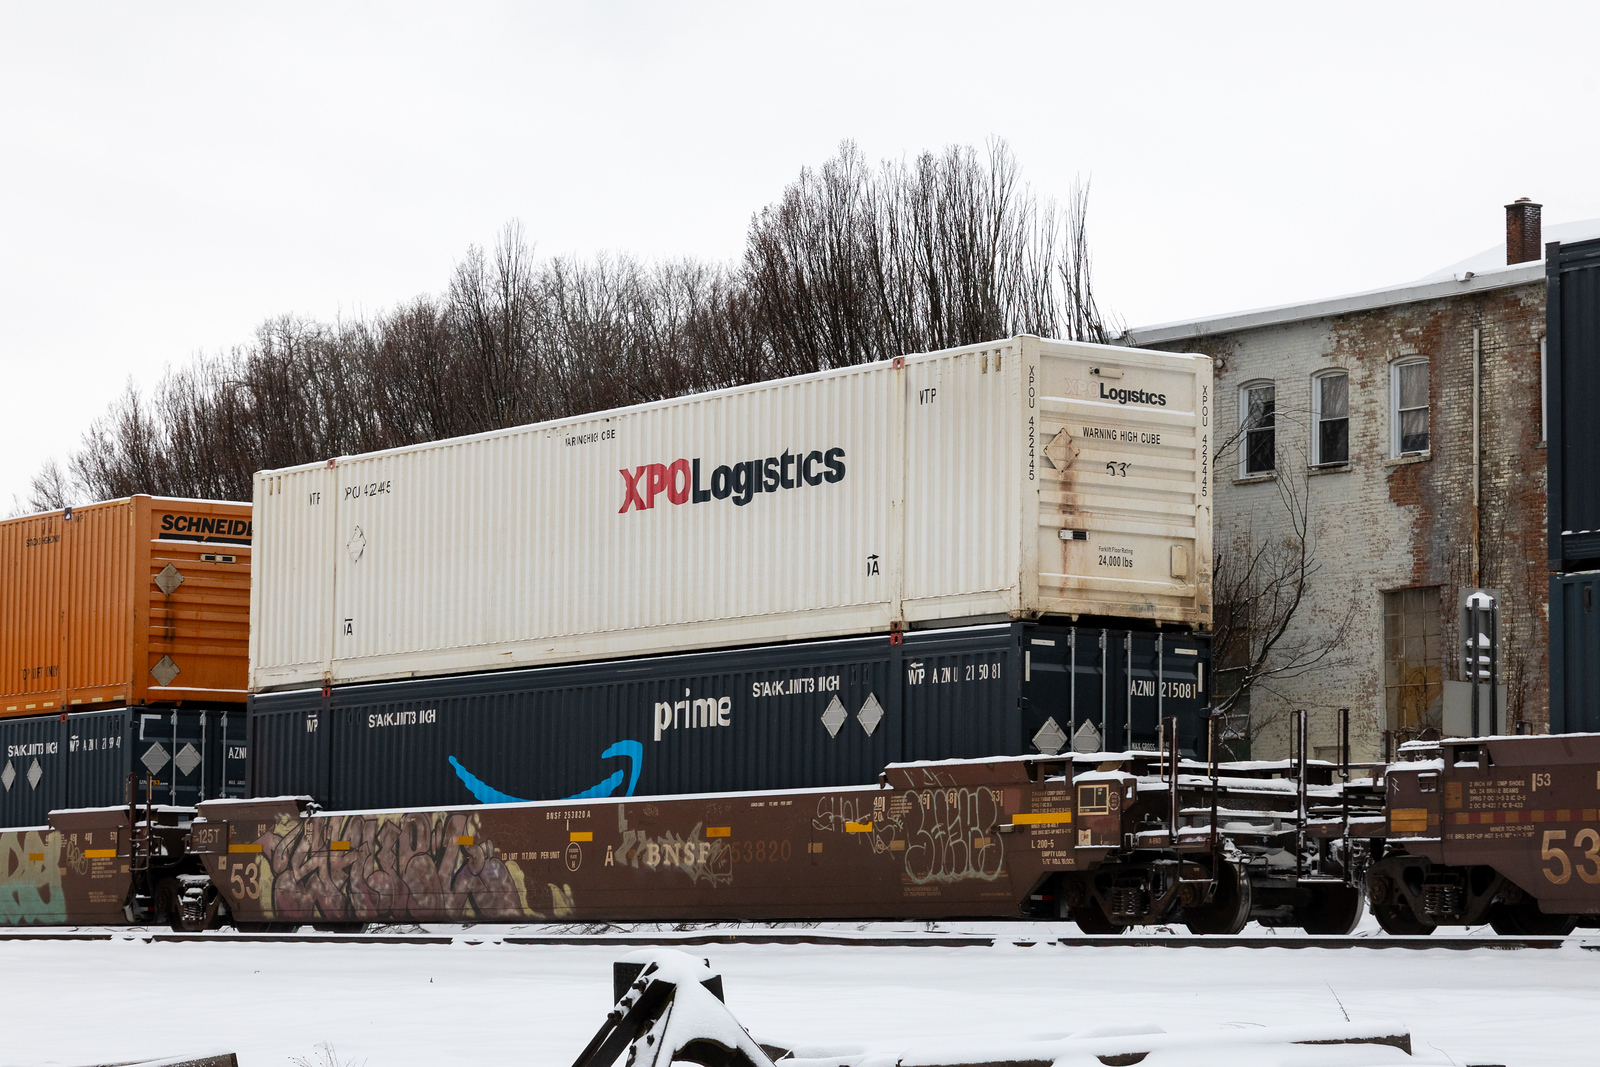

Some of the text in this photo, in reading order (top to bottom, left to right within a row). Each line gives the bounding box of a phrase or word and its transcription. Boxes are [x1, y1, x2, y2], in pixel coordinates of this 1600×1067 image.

[1028, 365, 1036, 409] XPOU
[1100, 382, 1167, 406] Logistics
[1082, 426, 1161, 445] WARNING HIGH CUBE
[1098, 554, 1133, 568] 24,000 lbs
[1130, 679, 1197, 699] AZNU 215081
[654, 687, 732, 741] prime
[1536, 773, 1551, 787] 53
[545, 811, 562, 820] BNSF
[564, 810, 586, 820] 253820
[645, 841, 711, 867] BNSF
[1541, 828, 1600, 885] 53
[230, 862, 260, 900] 53
